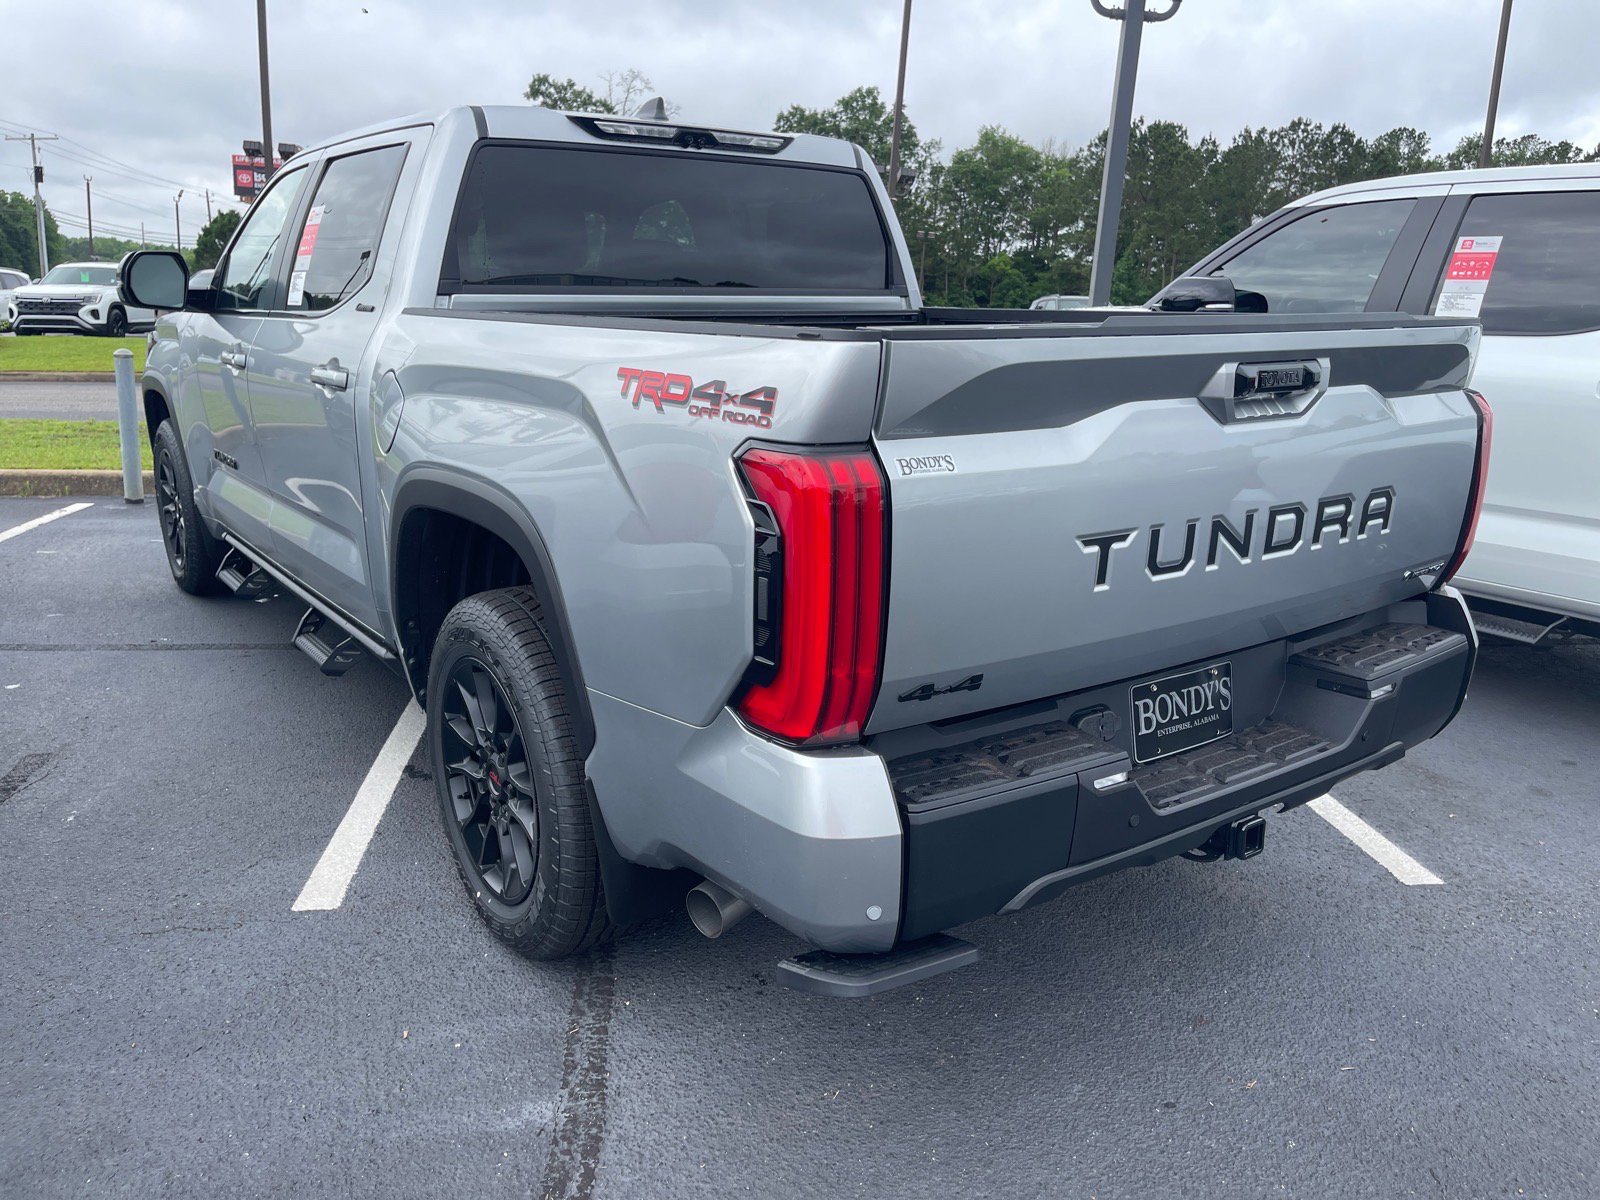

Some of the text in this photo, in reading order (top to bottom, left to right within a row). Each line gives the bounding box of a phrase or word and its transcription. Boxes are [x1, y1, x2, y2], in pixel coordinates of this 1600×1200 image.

[616, 366, 694, 415] TRD
[1260, 370, 1301, 388] TOYOTA
[688, 404, 773, 430] OFF ROAD
[896, 454, 955, 476] BONDY'S
[1074, 484, 1397, 593] TUNDRA
[1134, 676, 1231, 736] BONDY'S
[1193, 713, 1220, 728] ALABAMA
